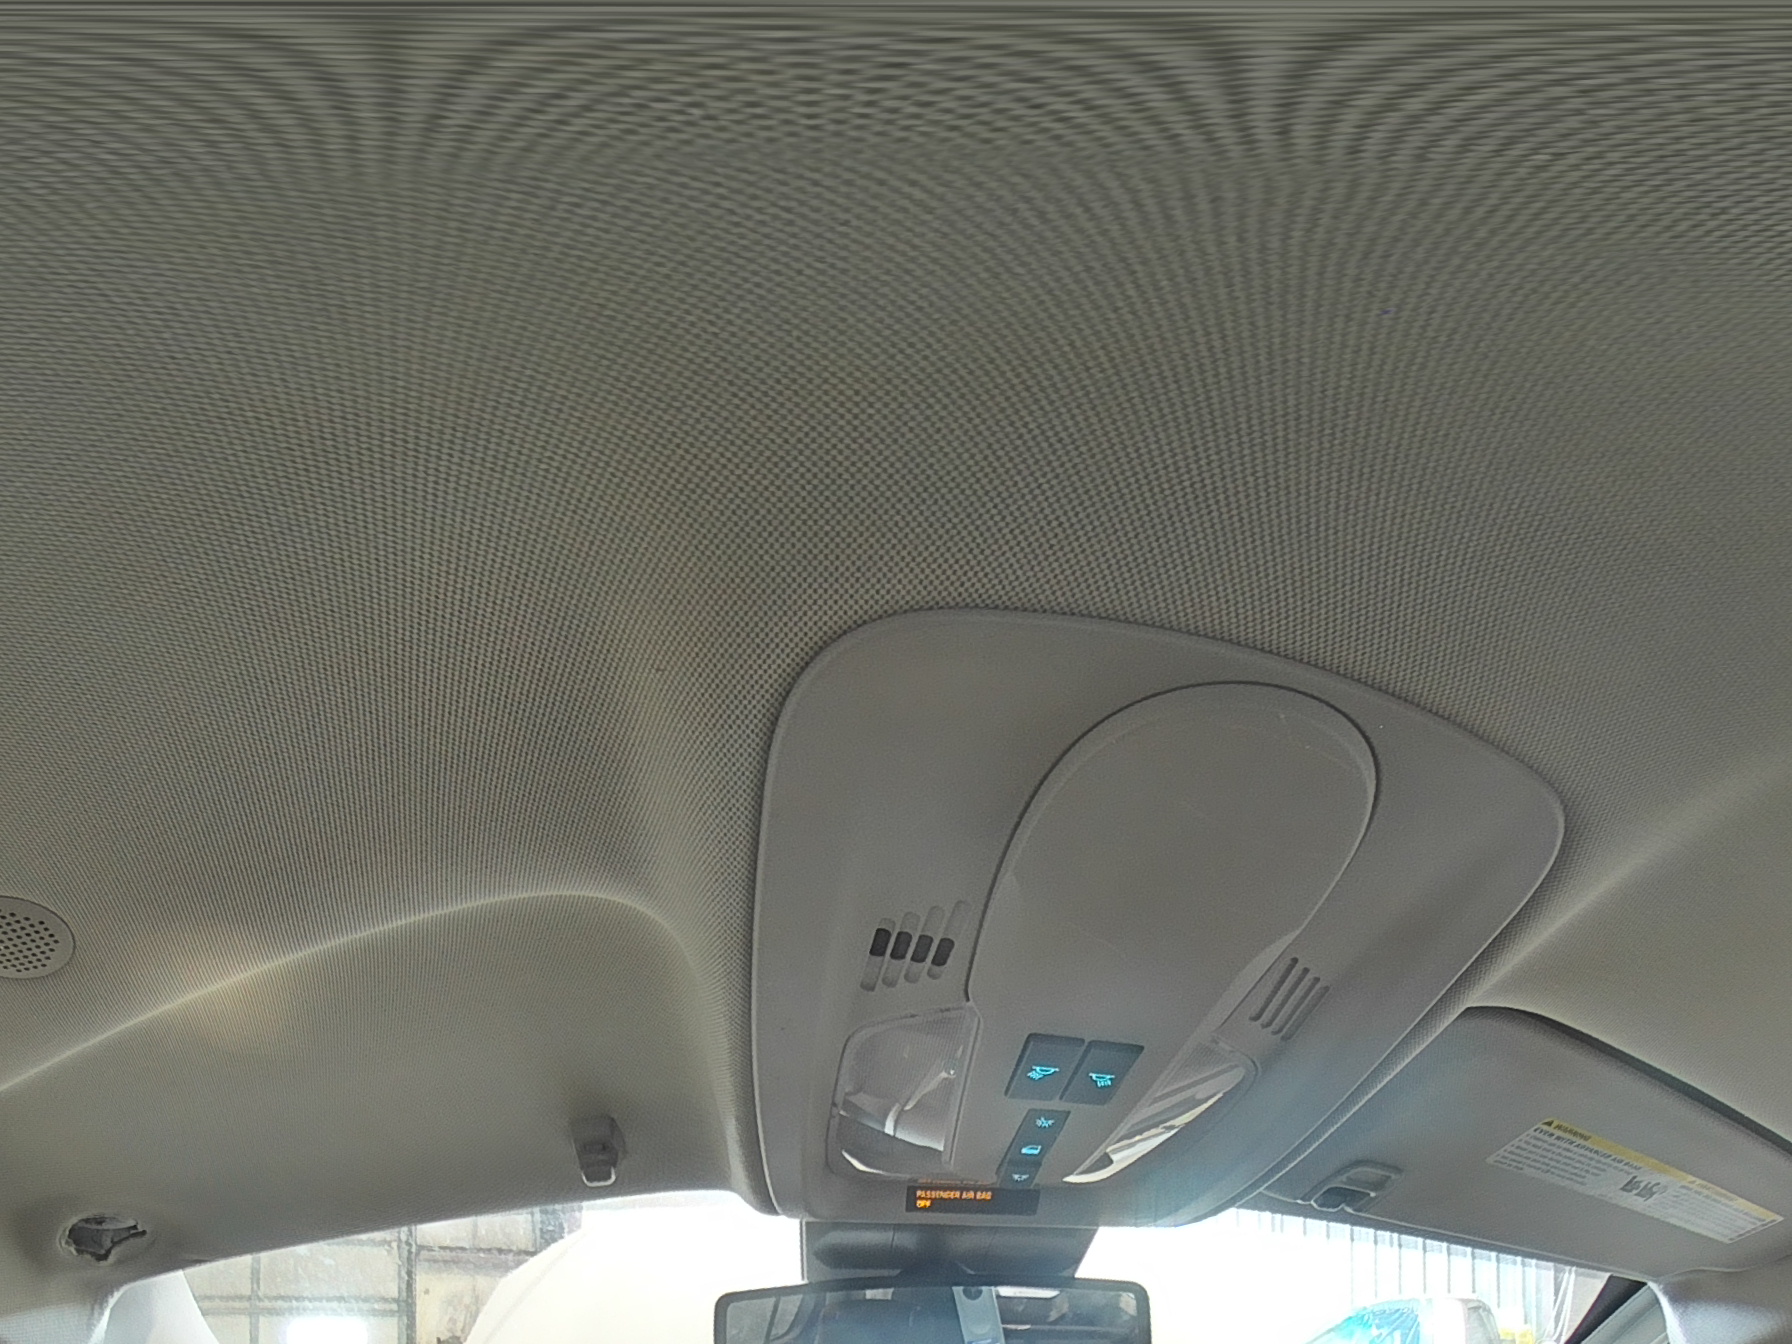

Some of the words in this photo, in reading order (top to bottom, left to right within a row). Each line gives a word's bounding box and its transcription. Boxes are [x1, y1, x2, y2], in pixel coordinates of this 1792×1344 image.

[916, 1190, 961, 1200] PASSENGER
[961, 1191, 975, 1199] AIR
[976, 1191, 992, 1200] BAG
[916, 1200, 932, 1208] OFF
